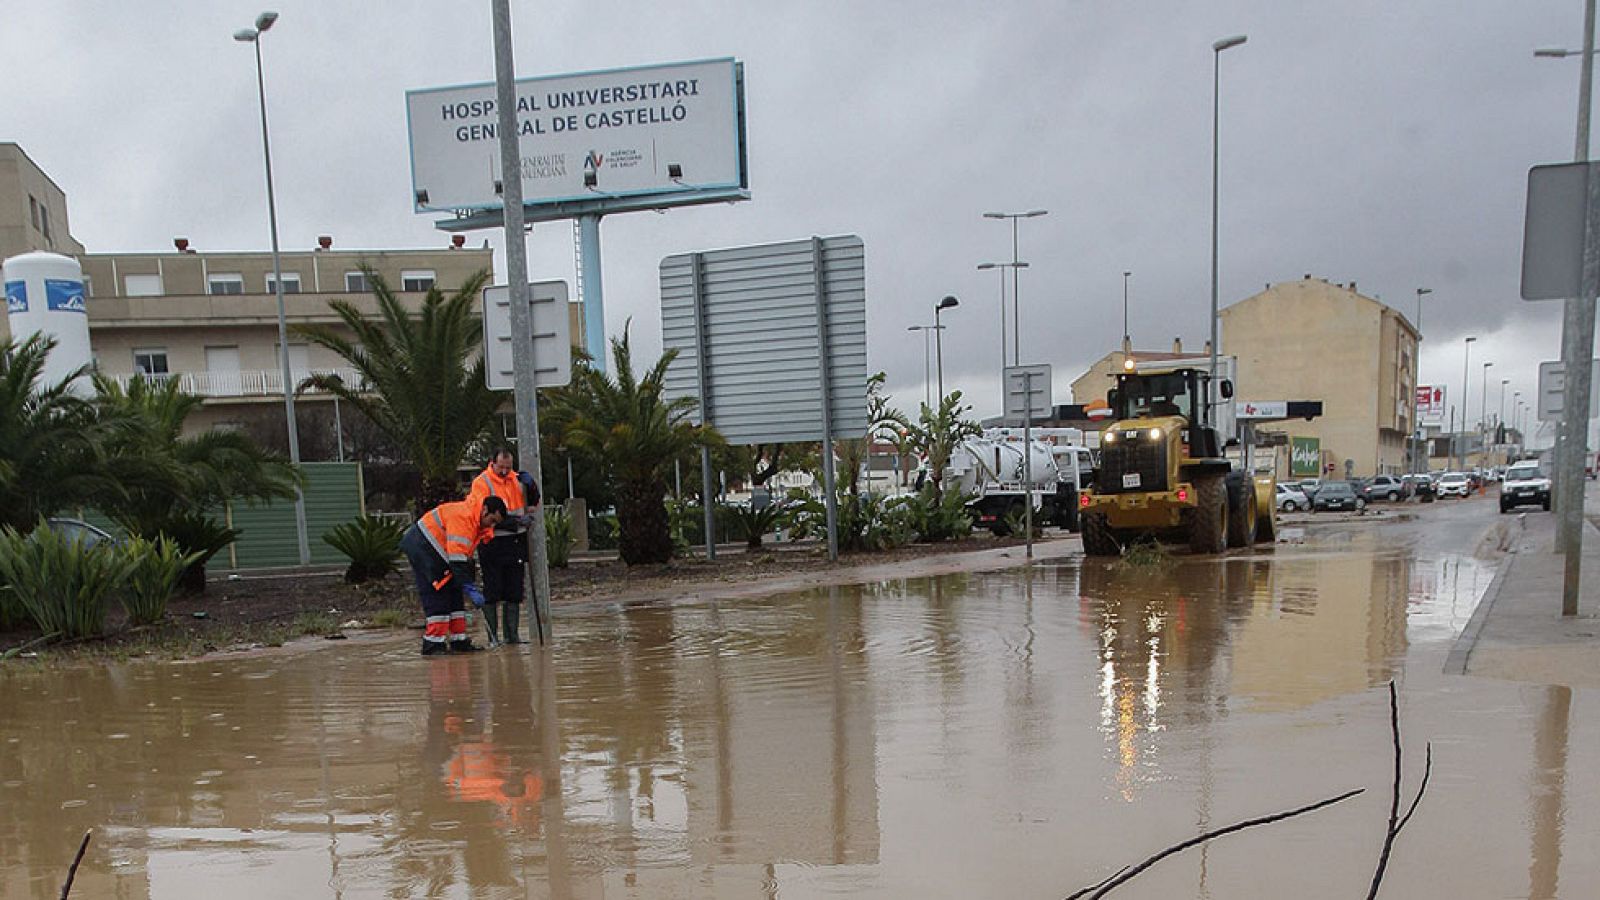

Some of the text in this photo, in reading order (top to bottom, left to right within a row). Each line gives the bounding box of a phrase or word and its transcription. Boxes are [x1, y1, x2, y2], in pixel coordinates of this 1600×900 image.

[442, 79, 698, 120] HOSPAL UNIVERSITARI
[456, 98, 687, 142] GENAL DE CASTELLÓ
